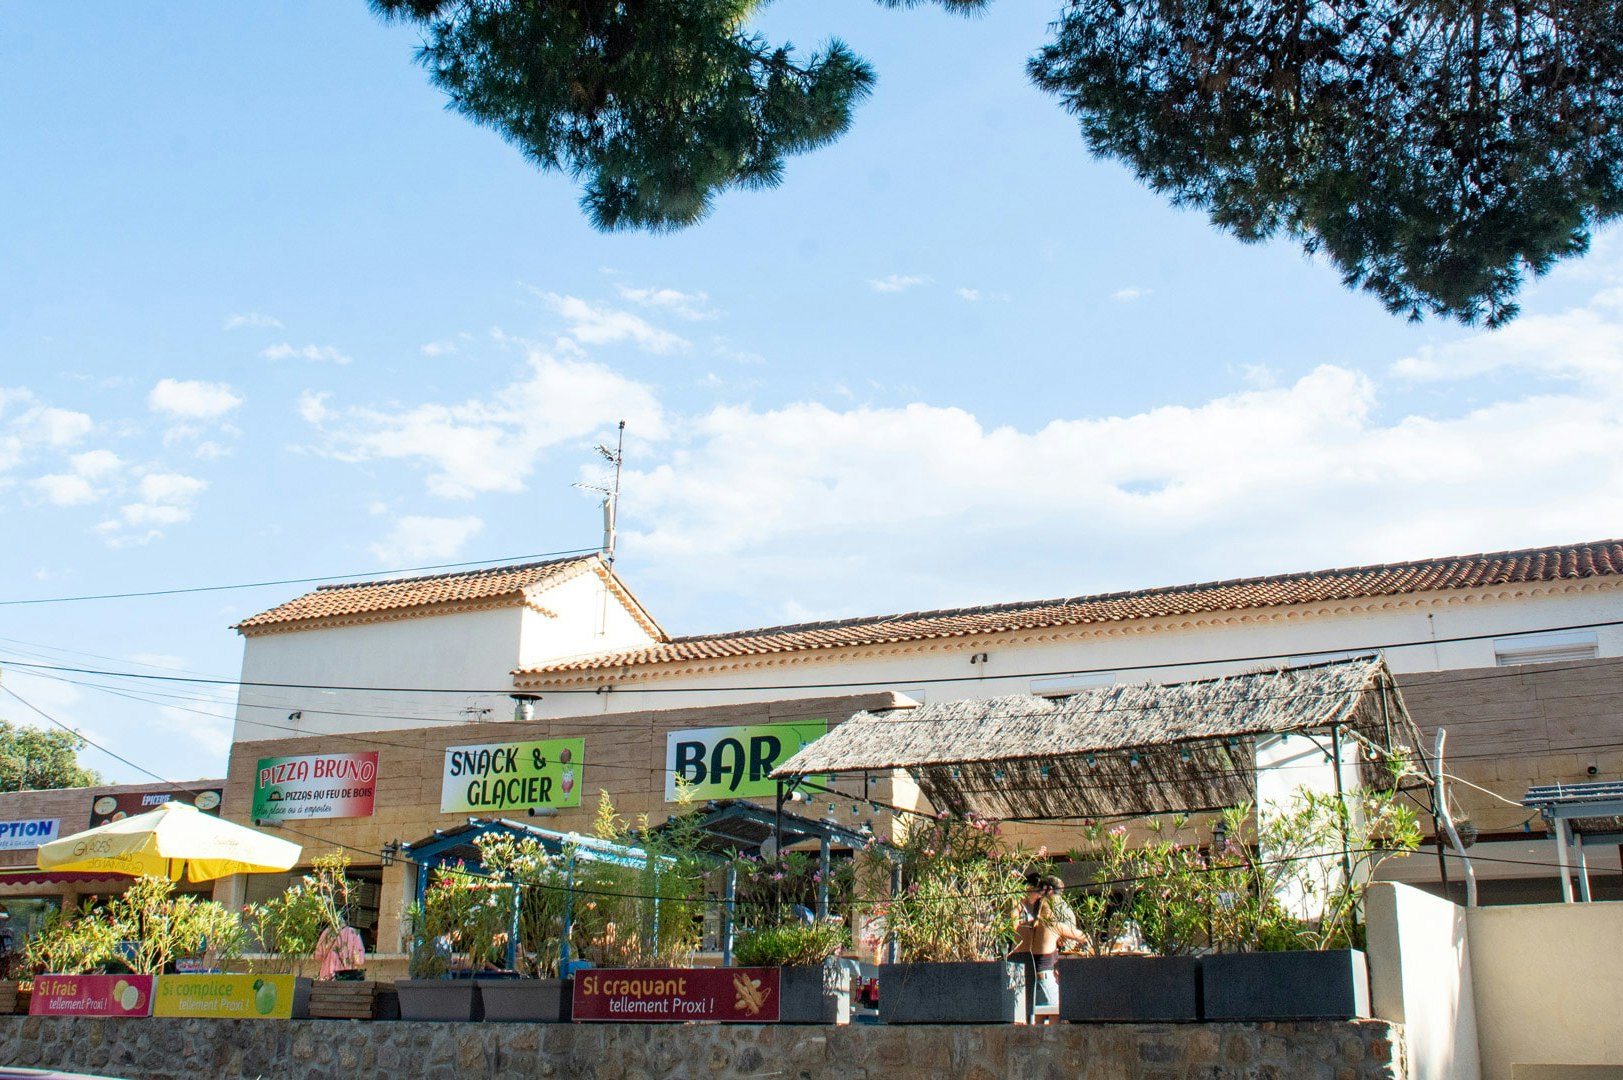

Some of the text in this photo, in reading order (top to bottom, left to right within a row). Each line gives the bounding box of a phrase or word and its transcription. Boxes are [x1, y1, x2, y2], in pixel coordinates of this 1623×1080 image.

[450, 747, 547, 778] SNACK &
[675, 735, 781, 792] BAR
[260, 758, 376, 789] PIZZA BRUNO
[285, 787, 373, 801] PIZZAS AU FEU DE BOIS
[467, 776, 552, 809] GLACIER
[268, 803, 287, 818] place
[304, 804, 332, 817] emporter
[73, 838, 113, 856] GLACES
[38, 980, 77, 996] Si frais
[162, 980, 233, 999] Si complice
[583, 976, 687, 999] Si craquant
[49, 996, 84, 1010] tellement
[86, 997, 103, 1010] Proxi
[179, 997, 218, 1011] tellement
[220, 998, 243, 1011] Proxi
[609, 996, 669, 1013] tellement
[672, 998, 706, 1013] Proxi
